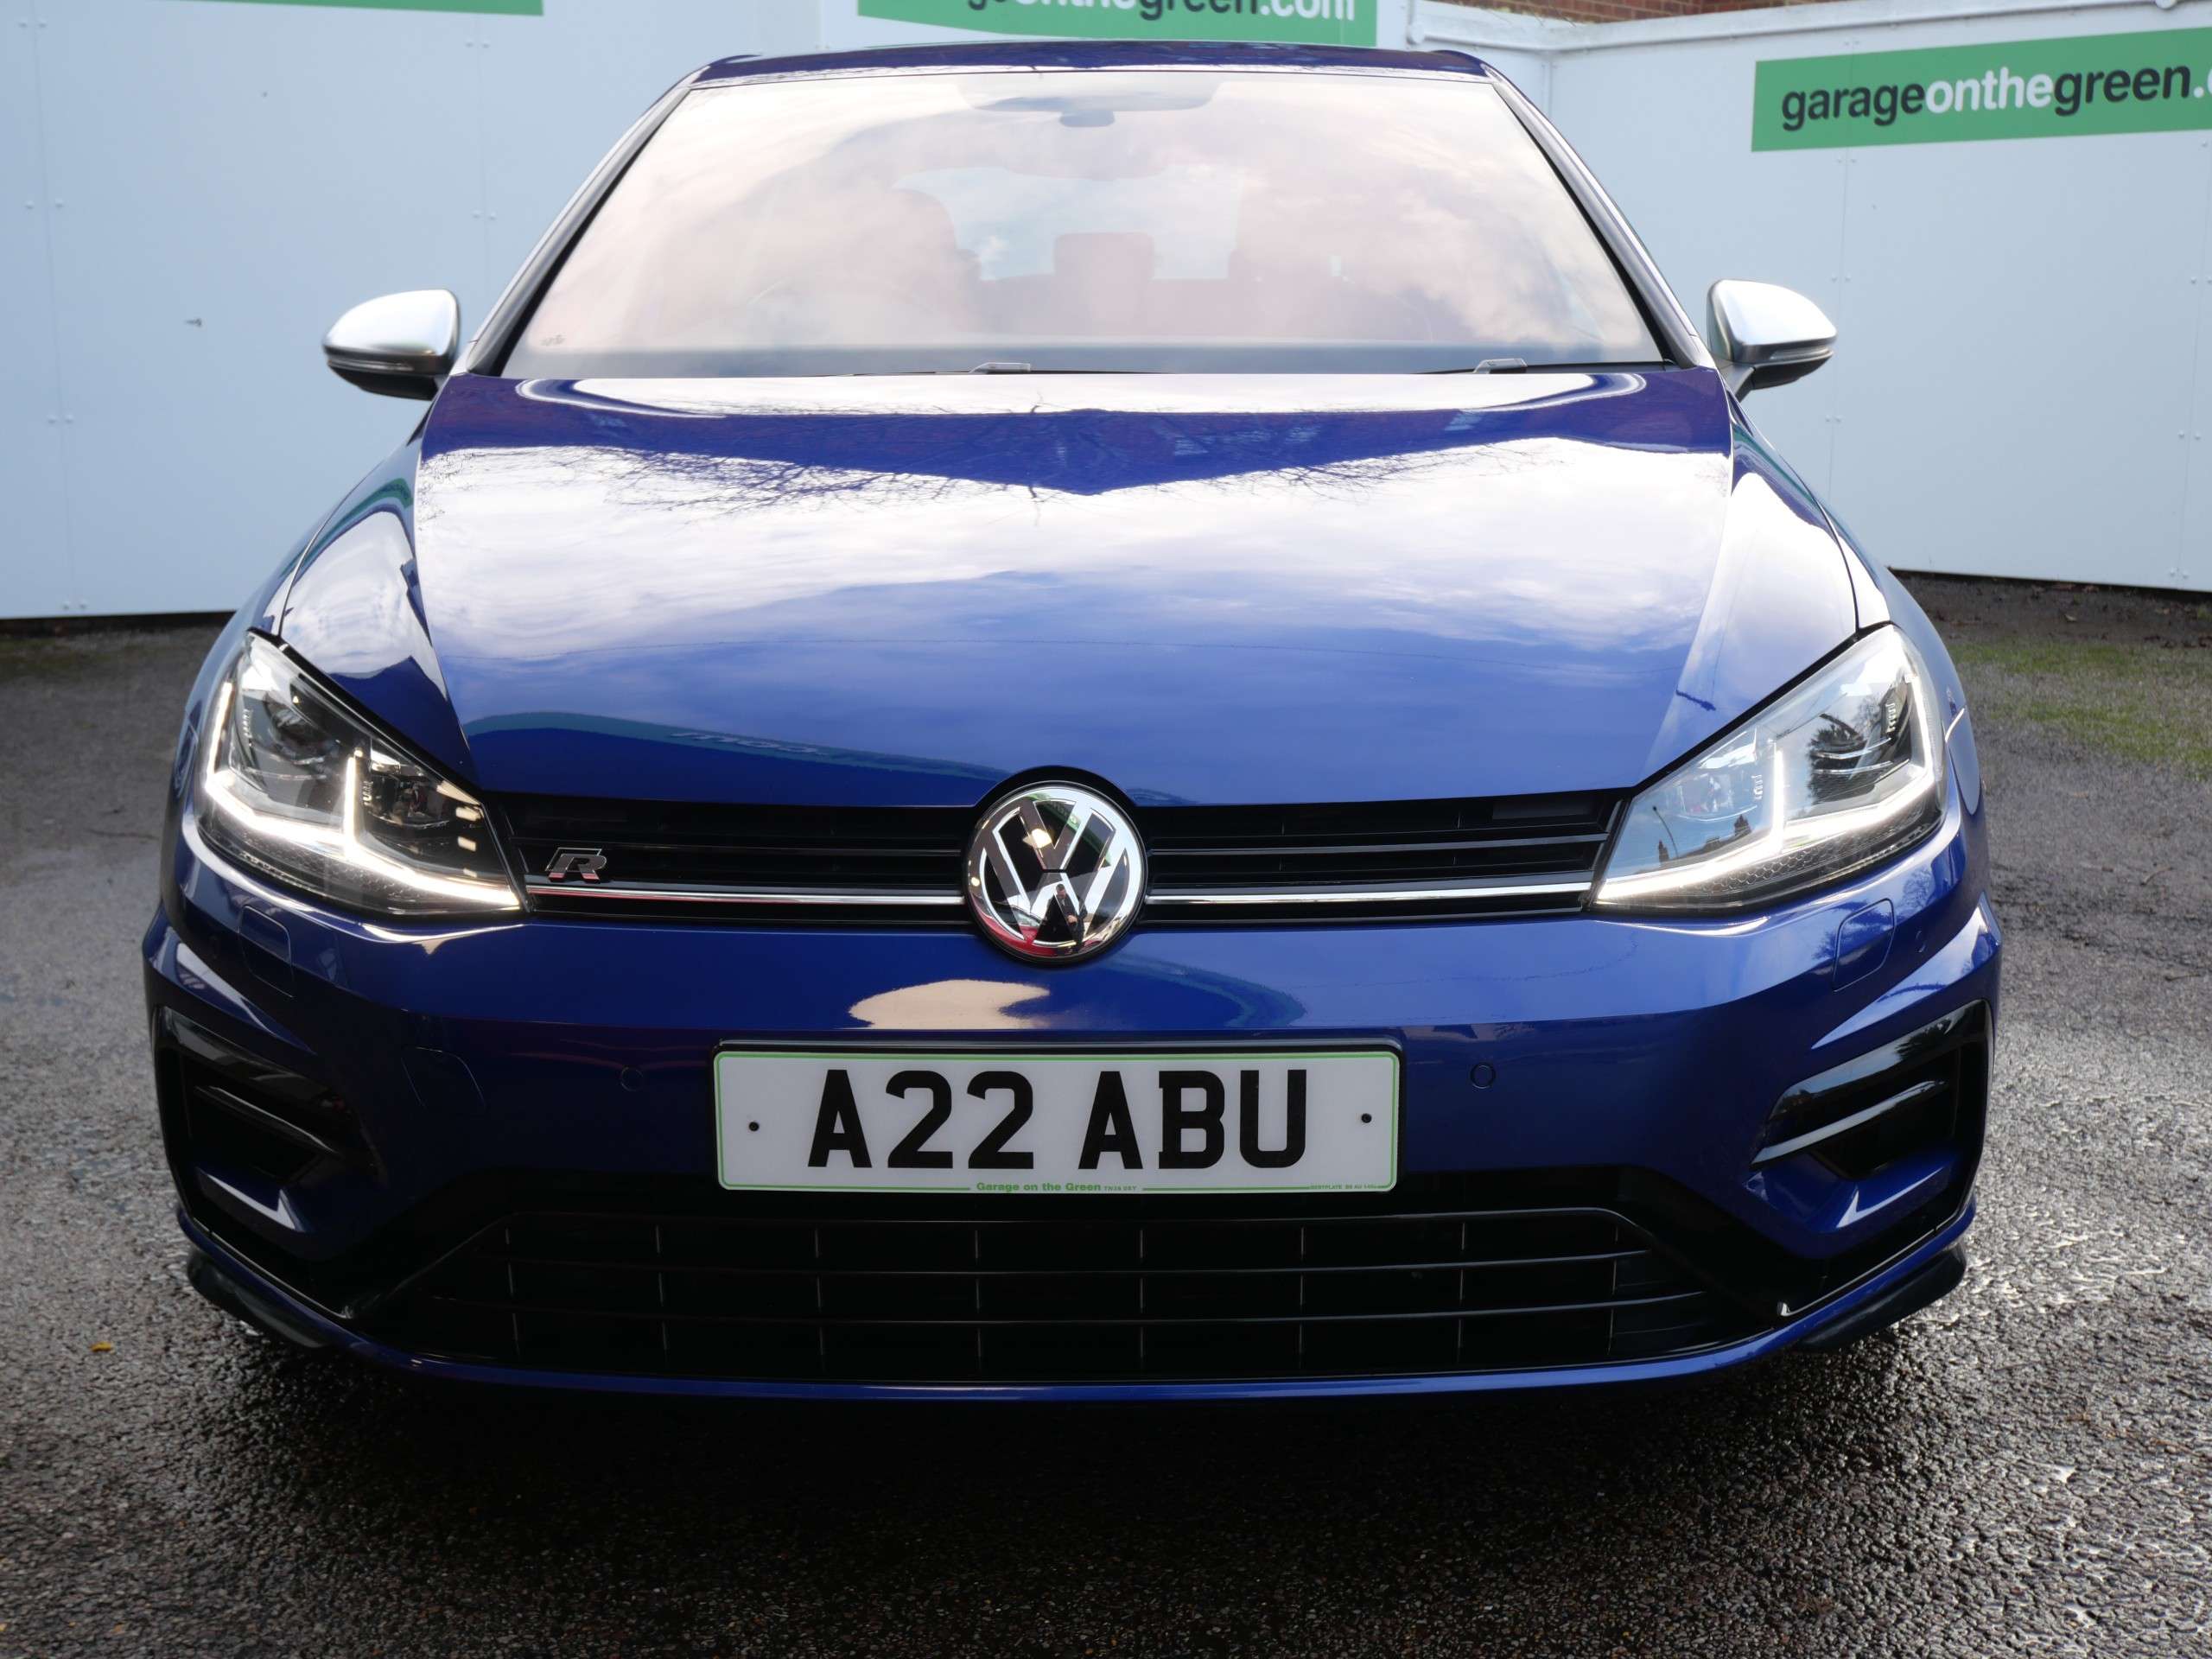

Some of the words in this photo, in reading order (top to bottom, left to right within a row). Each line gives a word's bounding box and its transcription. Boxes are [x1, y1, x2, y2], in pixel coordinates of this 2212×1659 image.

[1782, 66, 2212, 131] garageonthegreen.
[545, 847, 607, 881] R
[808, 1069, 1034, 1169] A22
[1078, 1069, 1306, 1169] ABU
[976, 1182, 1020, 1193] Garage
[1042, 1182, 1061, 1192] the
[1065, 1182, 1101, 1192] Green
